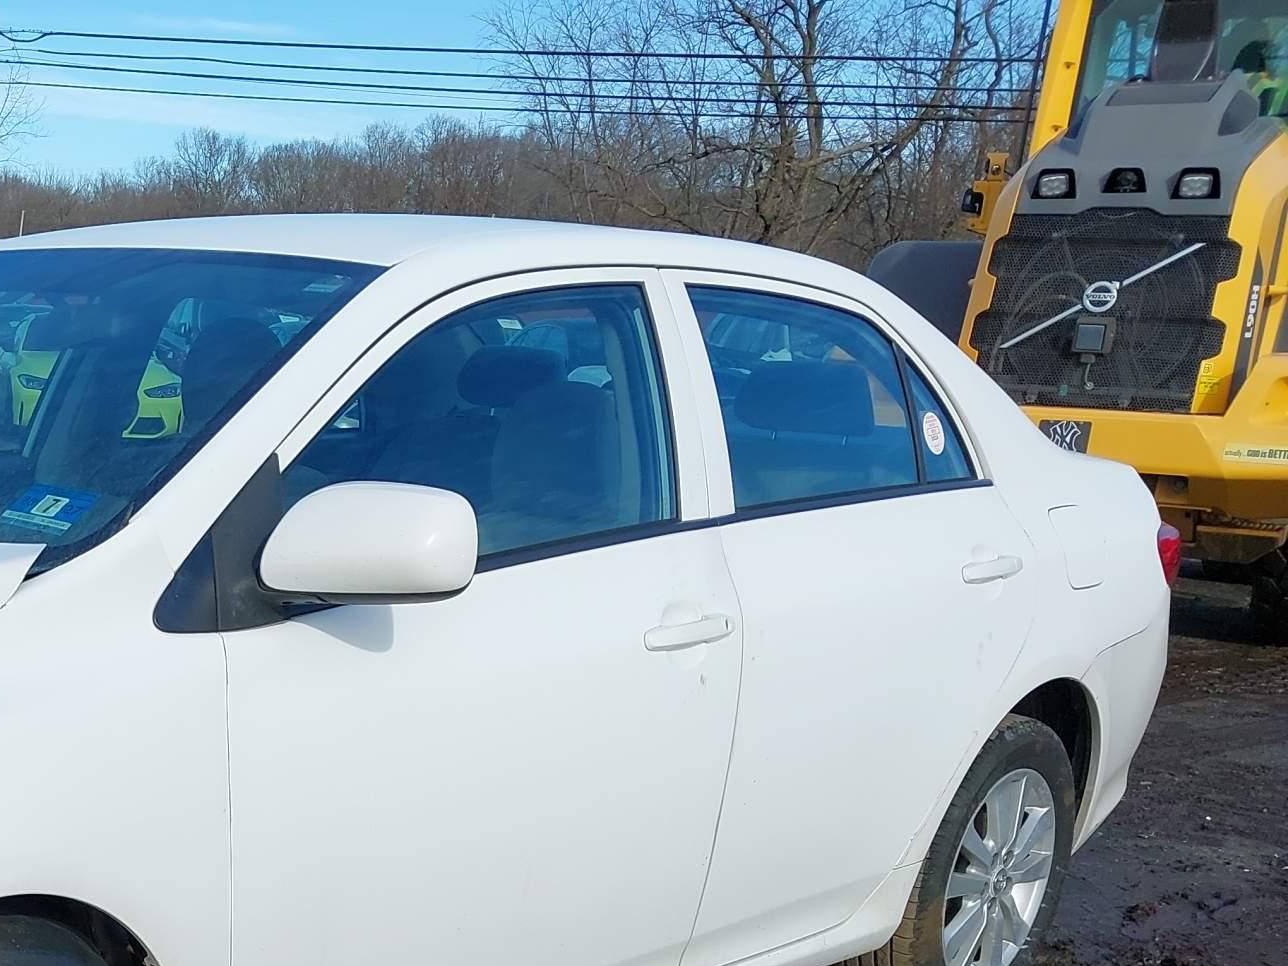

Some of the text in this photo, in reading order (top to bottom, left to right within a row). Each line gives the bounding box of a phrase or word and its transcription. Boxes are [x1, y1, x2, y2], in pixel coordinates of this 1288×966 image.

[1244, 285, 1260, 338] L90H
[1268, 448, 1288, 459] BETT
[43, 499, 62, 513] 7
